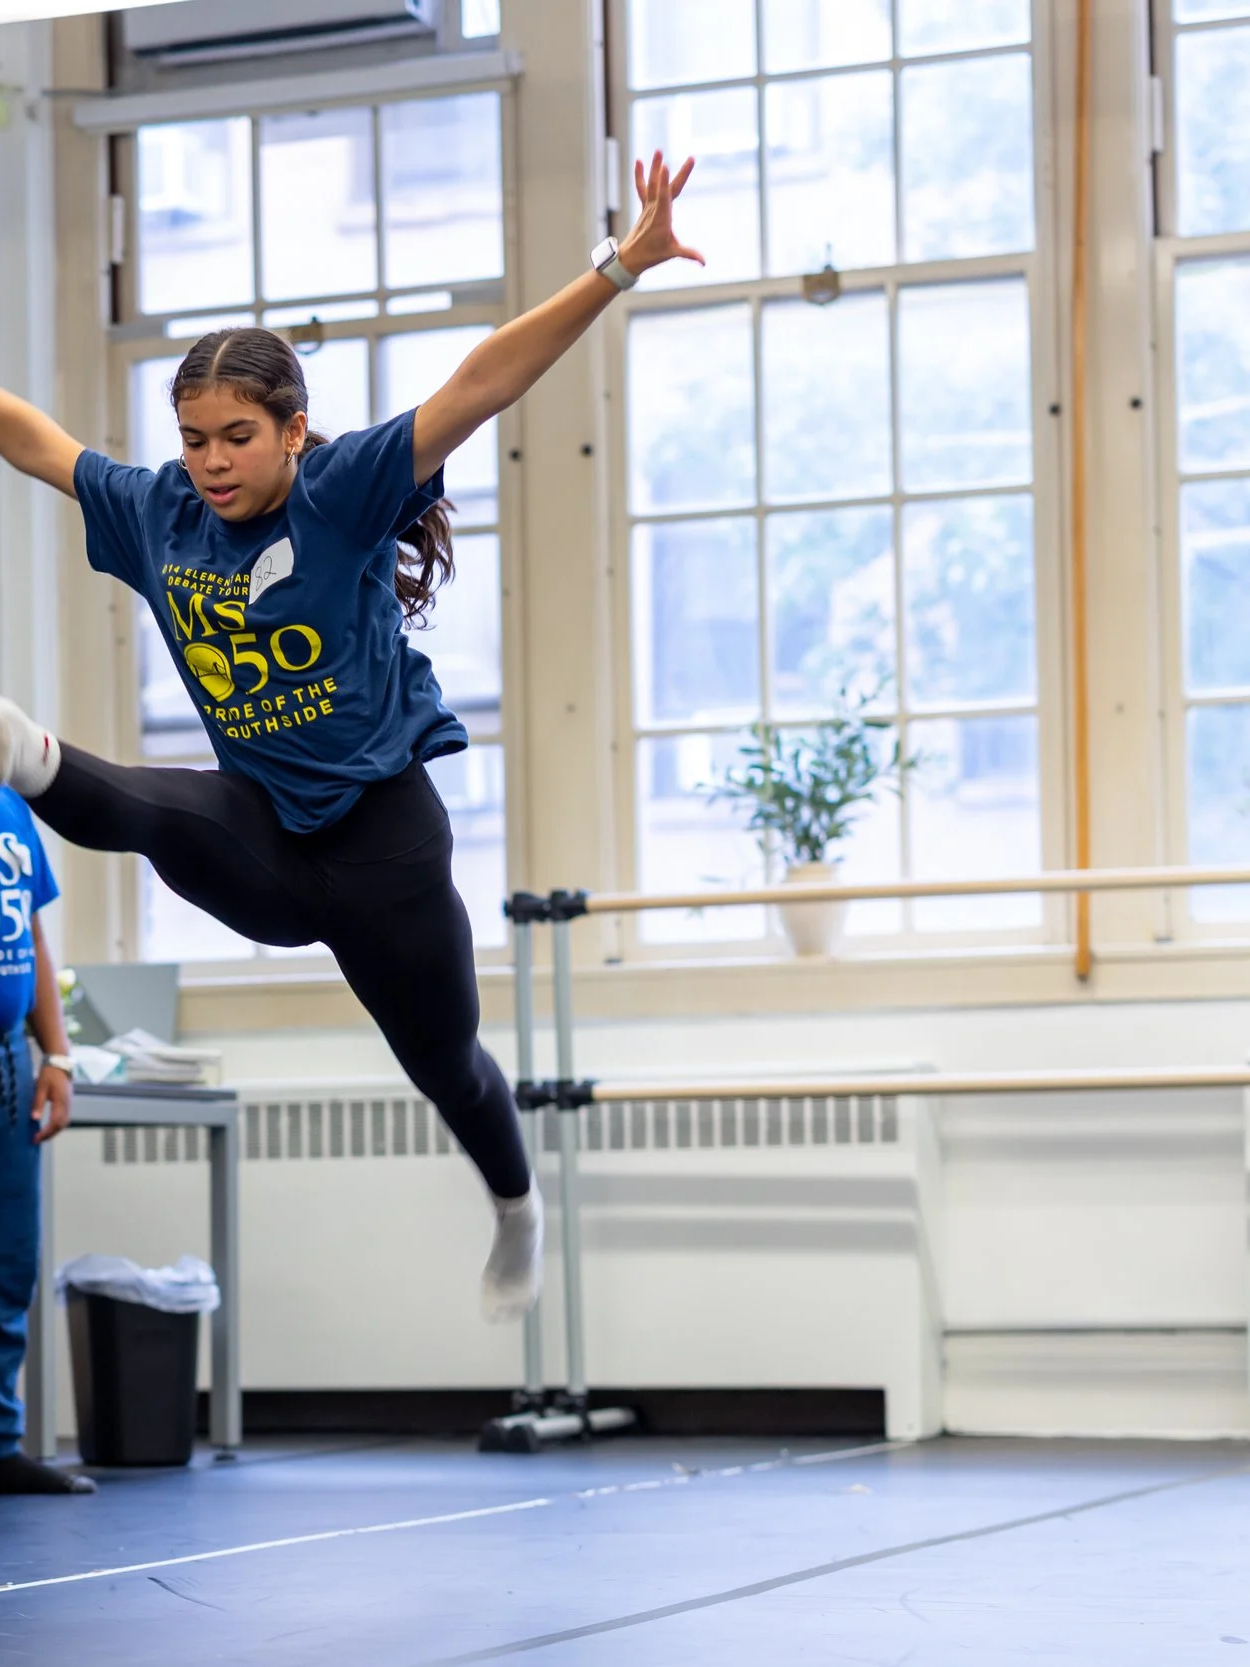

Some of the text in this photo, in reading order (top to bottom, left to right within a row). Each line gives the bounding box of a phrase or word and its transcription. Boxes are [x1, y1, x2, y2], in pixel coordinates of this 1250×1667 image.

[167, 575, 249, 597] DEBATE TOUR
[184, 567, 250, 587] ELEMENAR
[229, 624, 322, 695] 50
[260, 695, 286, 712] OF
[292, 677, 338, 704] THE
[218, 699, 334, 740] OUTHSIDE
